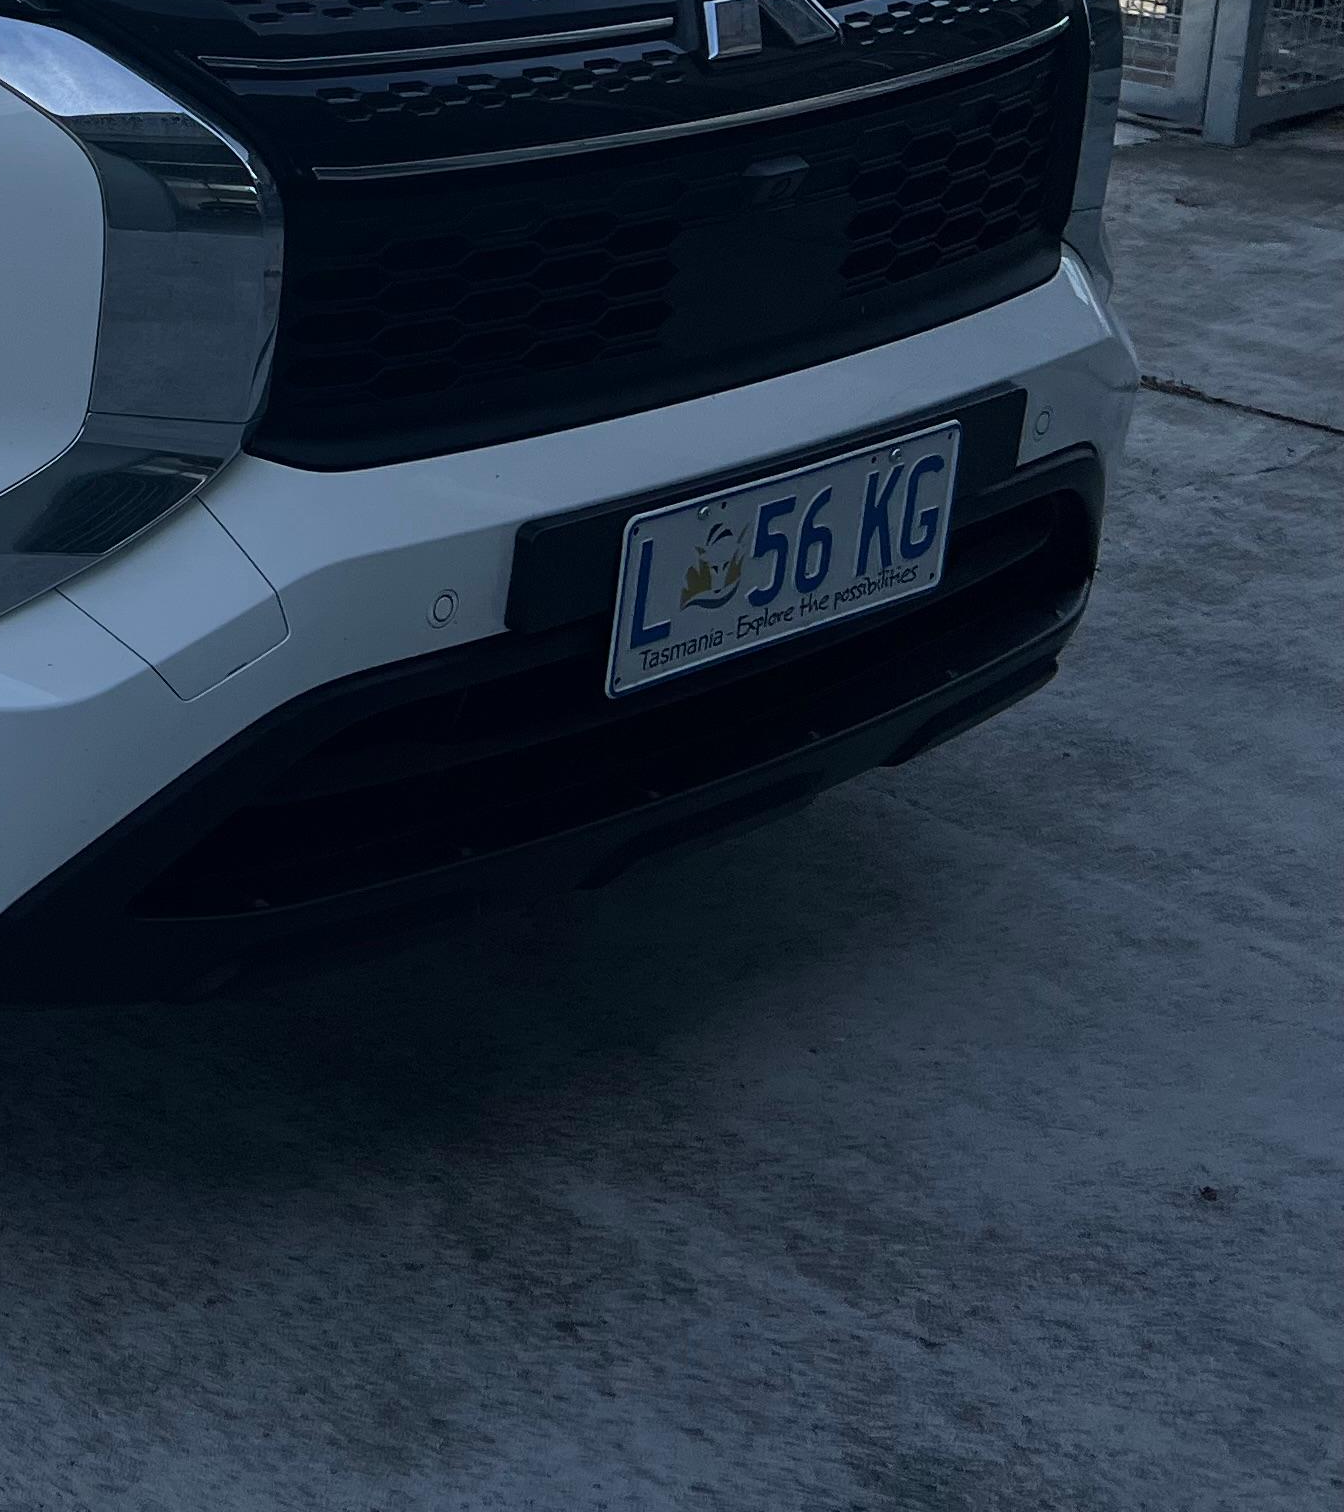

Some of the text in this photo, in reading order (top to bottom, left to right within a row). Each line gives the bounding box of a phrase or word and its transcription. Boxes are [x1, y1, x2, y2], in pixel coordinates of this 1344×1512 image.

[629, 454, 946, 650] L 56 KG
[639, 628, 724, 672] Tasmania
[736, 607, 795, 639] Explore
[799, 592, 831, 618] the
[833, 564, 920, 611] possibilities
